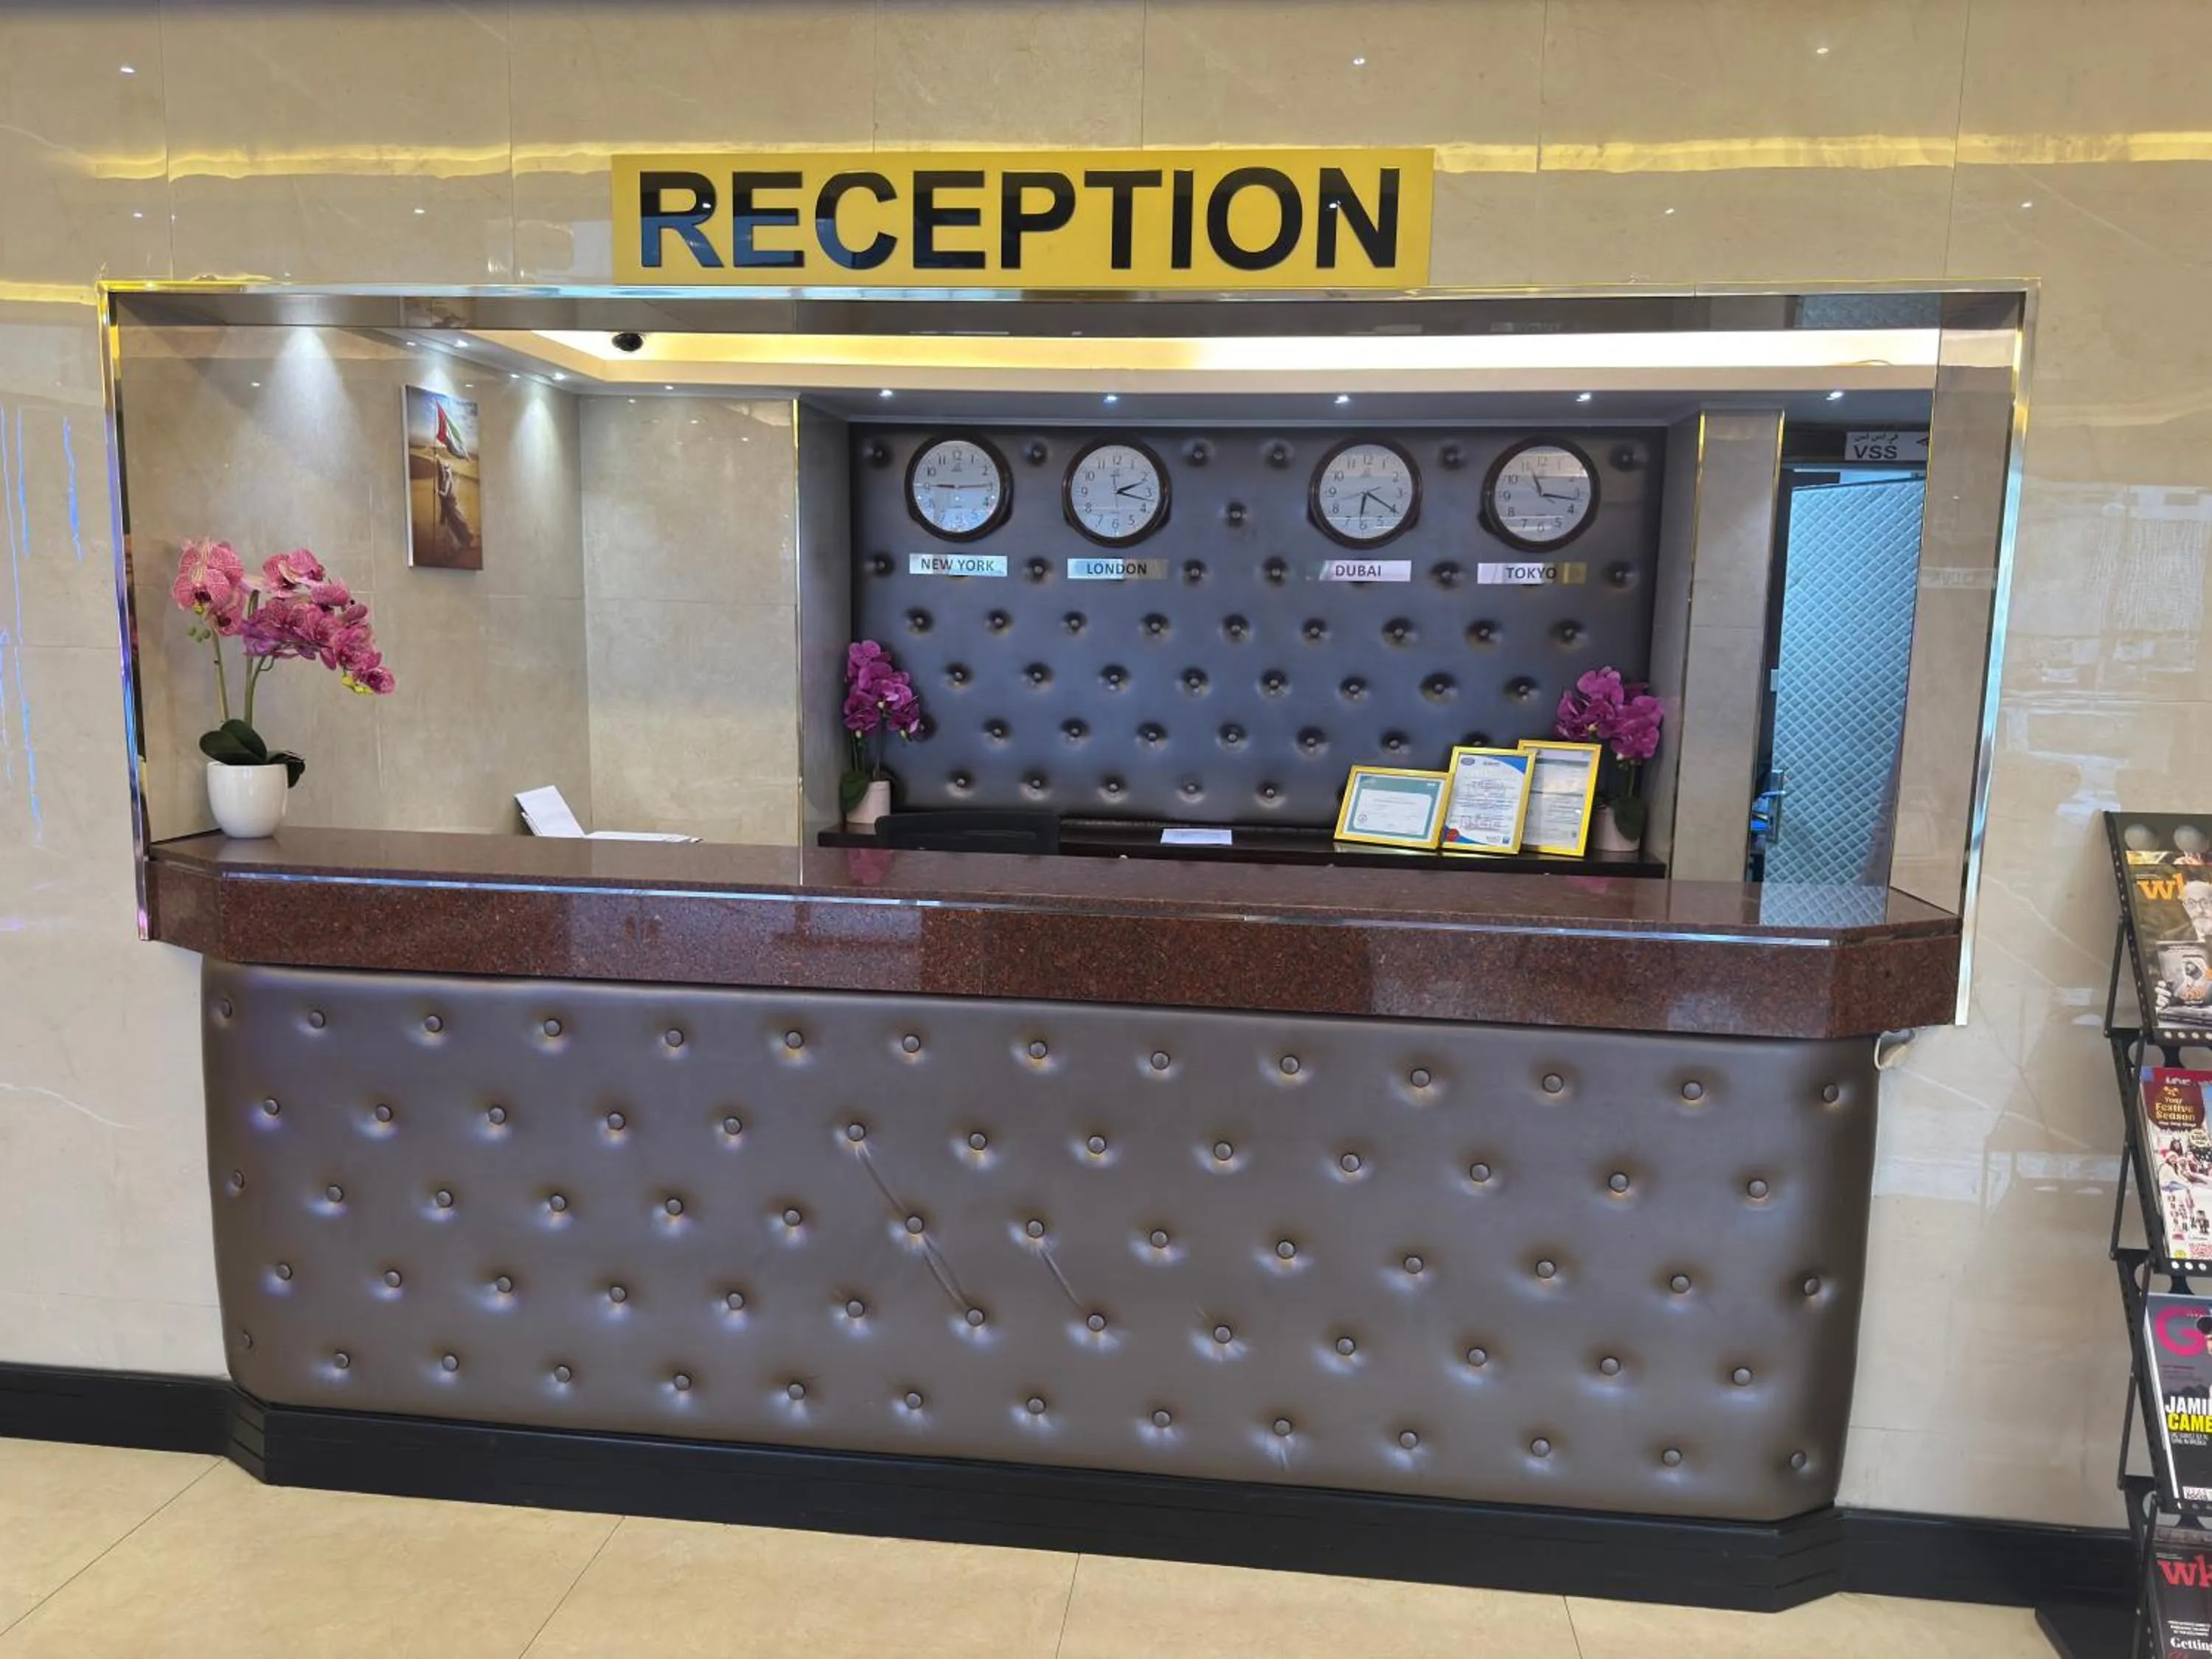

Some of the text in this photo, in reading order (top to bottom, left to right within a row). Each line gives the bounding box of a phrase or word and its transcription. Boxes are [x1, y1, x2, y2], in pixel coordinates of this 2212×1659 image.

[638, 167, 1401, 271] RECEPTION
[1853, 445, 1899, 459] VSS
[1098, 459, 1105, 470] 11
[1112, 454, 1121, 465] 12
[1085, 471, 1095, 481] 10
[1335, 471, 1343, 481] 10
[1081, 487, 1088, 497] 9
[1145, 488, 1152, 498] 3
[1328, 487, 1337, 497] 9
[1503, 490, 1511, 501] 9
[1085, 502, 1092, 514] 8
[1139, 502, 1147, 512] 4
[1332, 504, 1339, 514] 8
[1508, 507, 1514, 517] 8
[1567, 504, 1574, 514] 4
[1112, 518, 1119, 529] 6
[1127, 514, 1135, 525] 5
[1521, 518, 1528, 529] 7
[1554, 518, 1562, 528] 5
[1537, 522, 1545, 532] 6
[921, 558, 994, 571] NEW YORK
[1086, 563, 1147, 575] LONDON
[1335, 564, 1382, 577] DUBAI
[1506, 566, 1557, 580] TOKYO
[2155, 1102, 2194, 1113] Festive
[2155, 1110, 2196, 1121] Season
[2168, 1413, 2212, 1433] CAME
